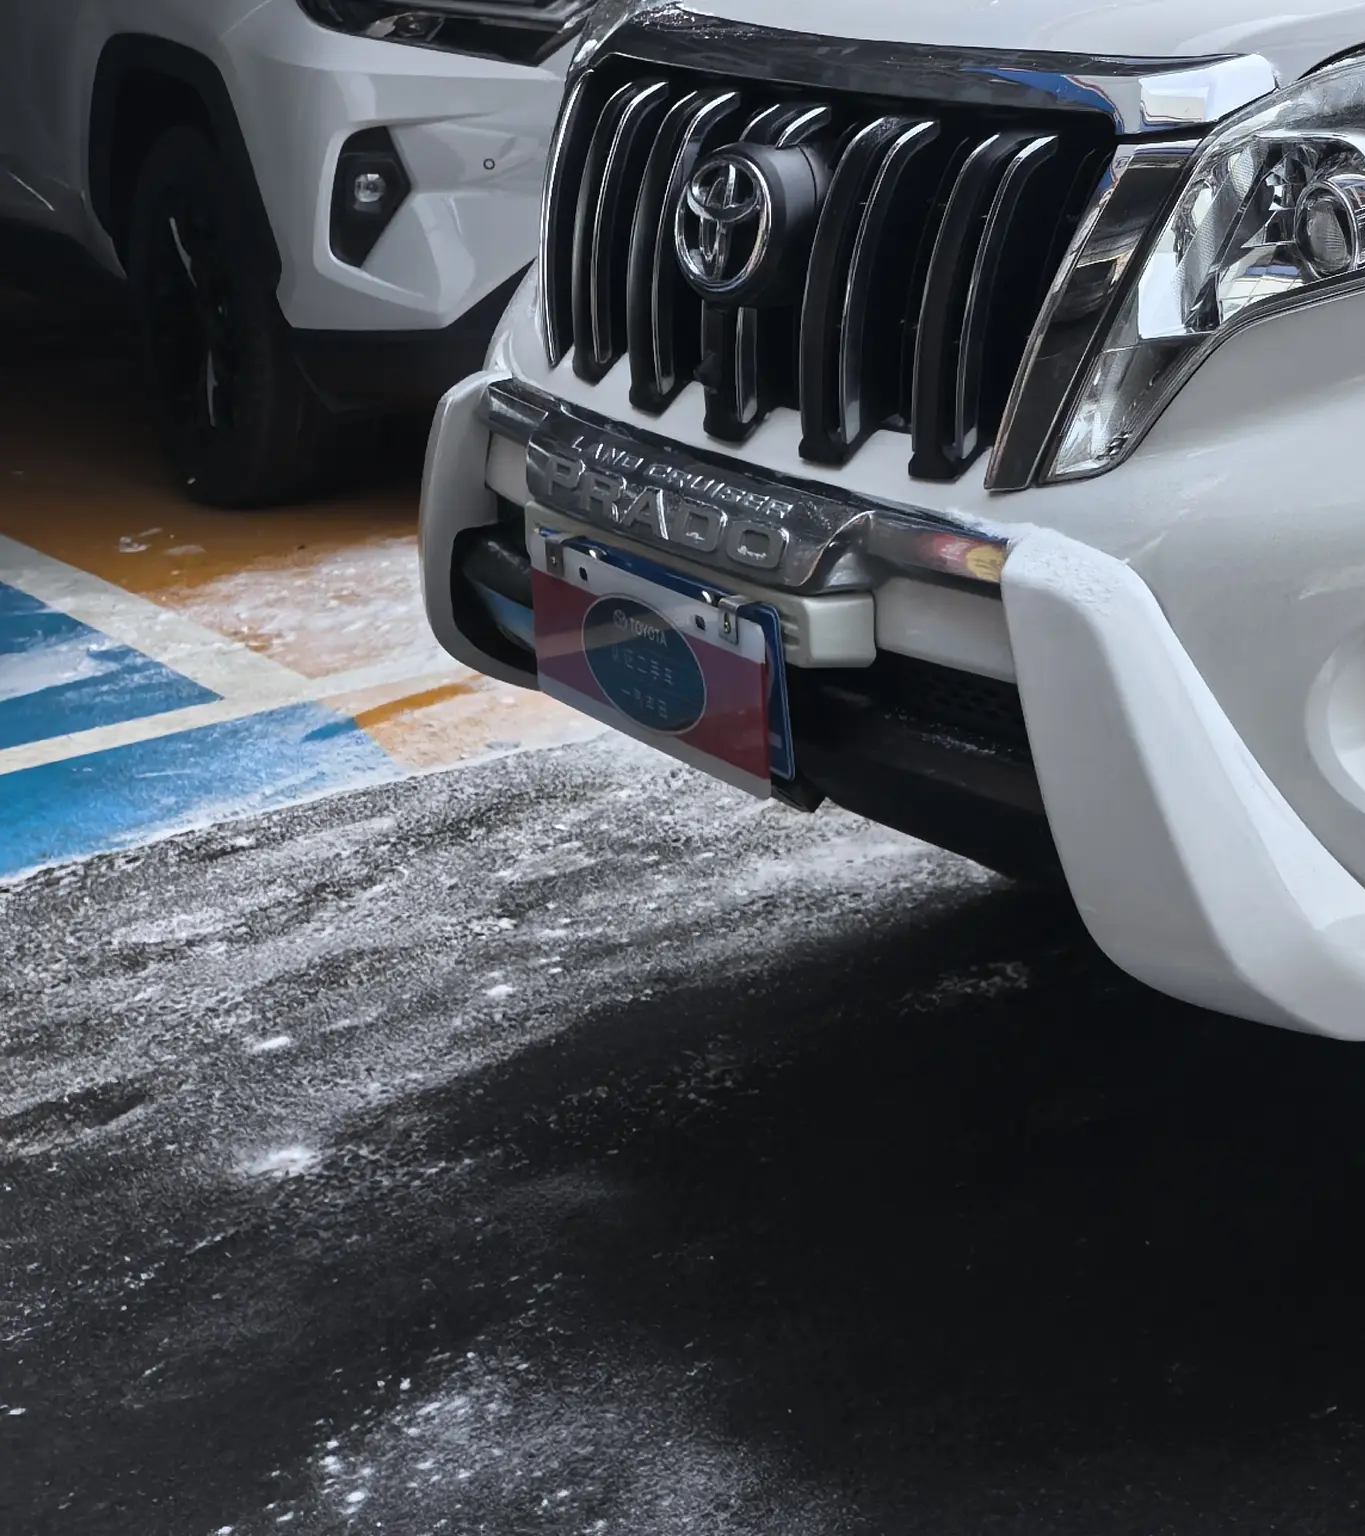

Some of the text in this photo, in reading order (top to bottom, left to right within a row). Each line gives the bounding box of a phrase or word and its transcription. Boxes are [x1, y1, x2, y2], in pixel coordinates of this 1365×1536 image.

[547, 459, 790, 569] PRADO
[571, 435, 794, 519] LAND CRUISER
[628, 617, 668, 647] TOYOTA
